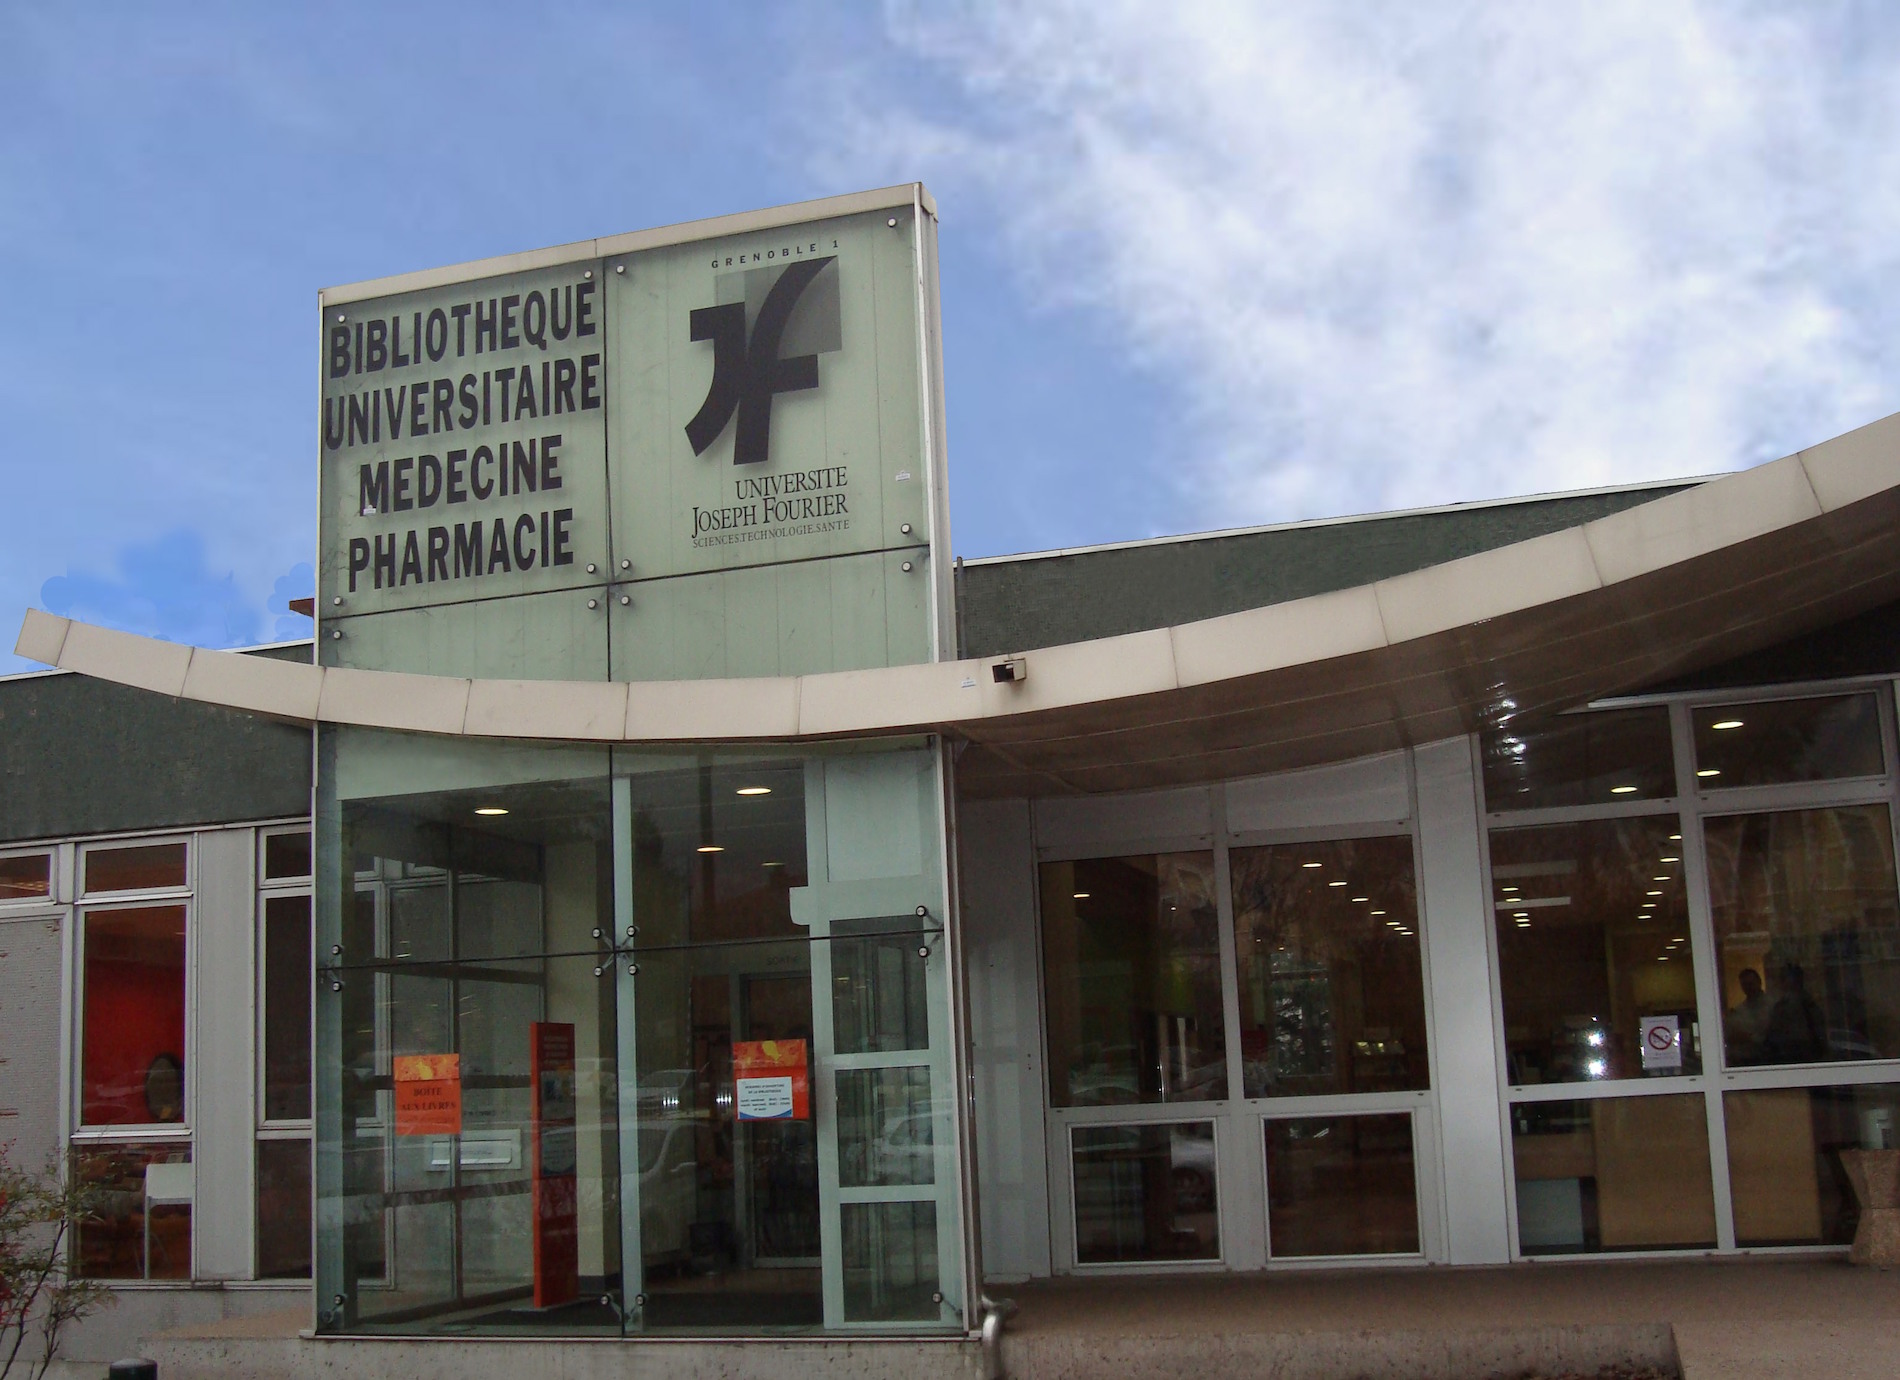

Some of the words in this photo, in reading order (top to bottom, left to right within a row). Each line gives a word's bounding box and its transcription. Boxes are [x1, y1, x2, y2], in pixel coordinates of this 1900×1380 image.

[711, 243, 816, 269] GRENOBLE
[832, 239, 839, 249] 1
[329, 281, 596, 379] BIBLIOTHEQUE
[325, 353, 601, 450] UNIVERSITAIRE
[359, 434, 562, 517] MEDECINE
[691, 504, 757, 539] JOSEPH
[762, 493, 849, 524] FOURIER
[735, 466, 848, 500] UNIVERSITE
[349, 507, 574, 593] PHARMACIE
